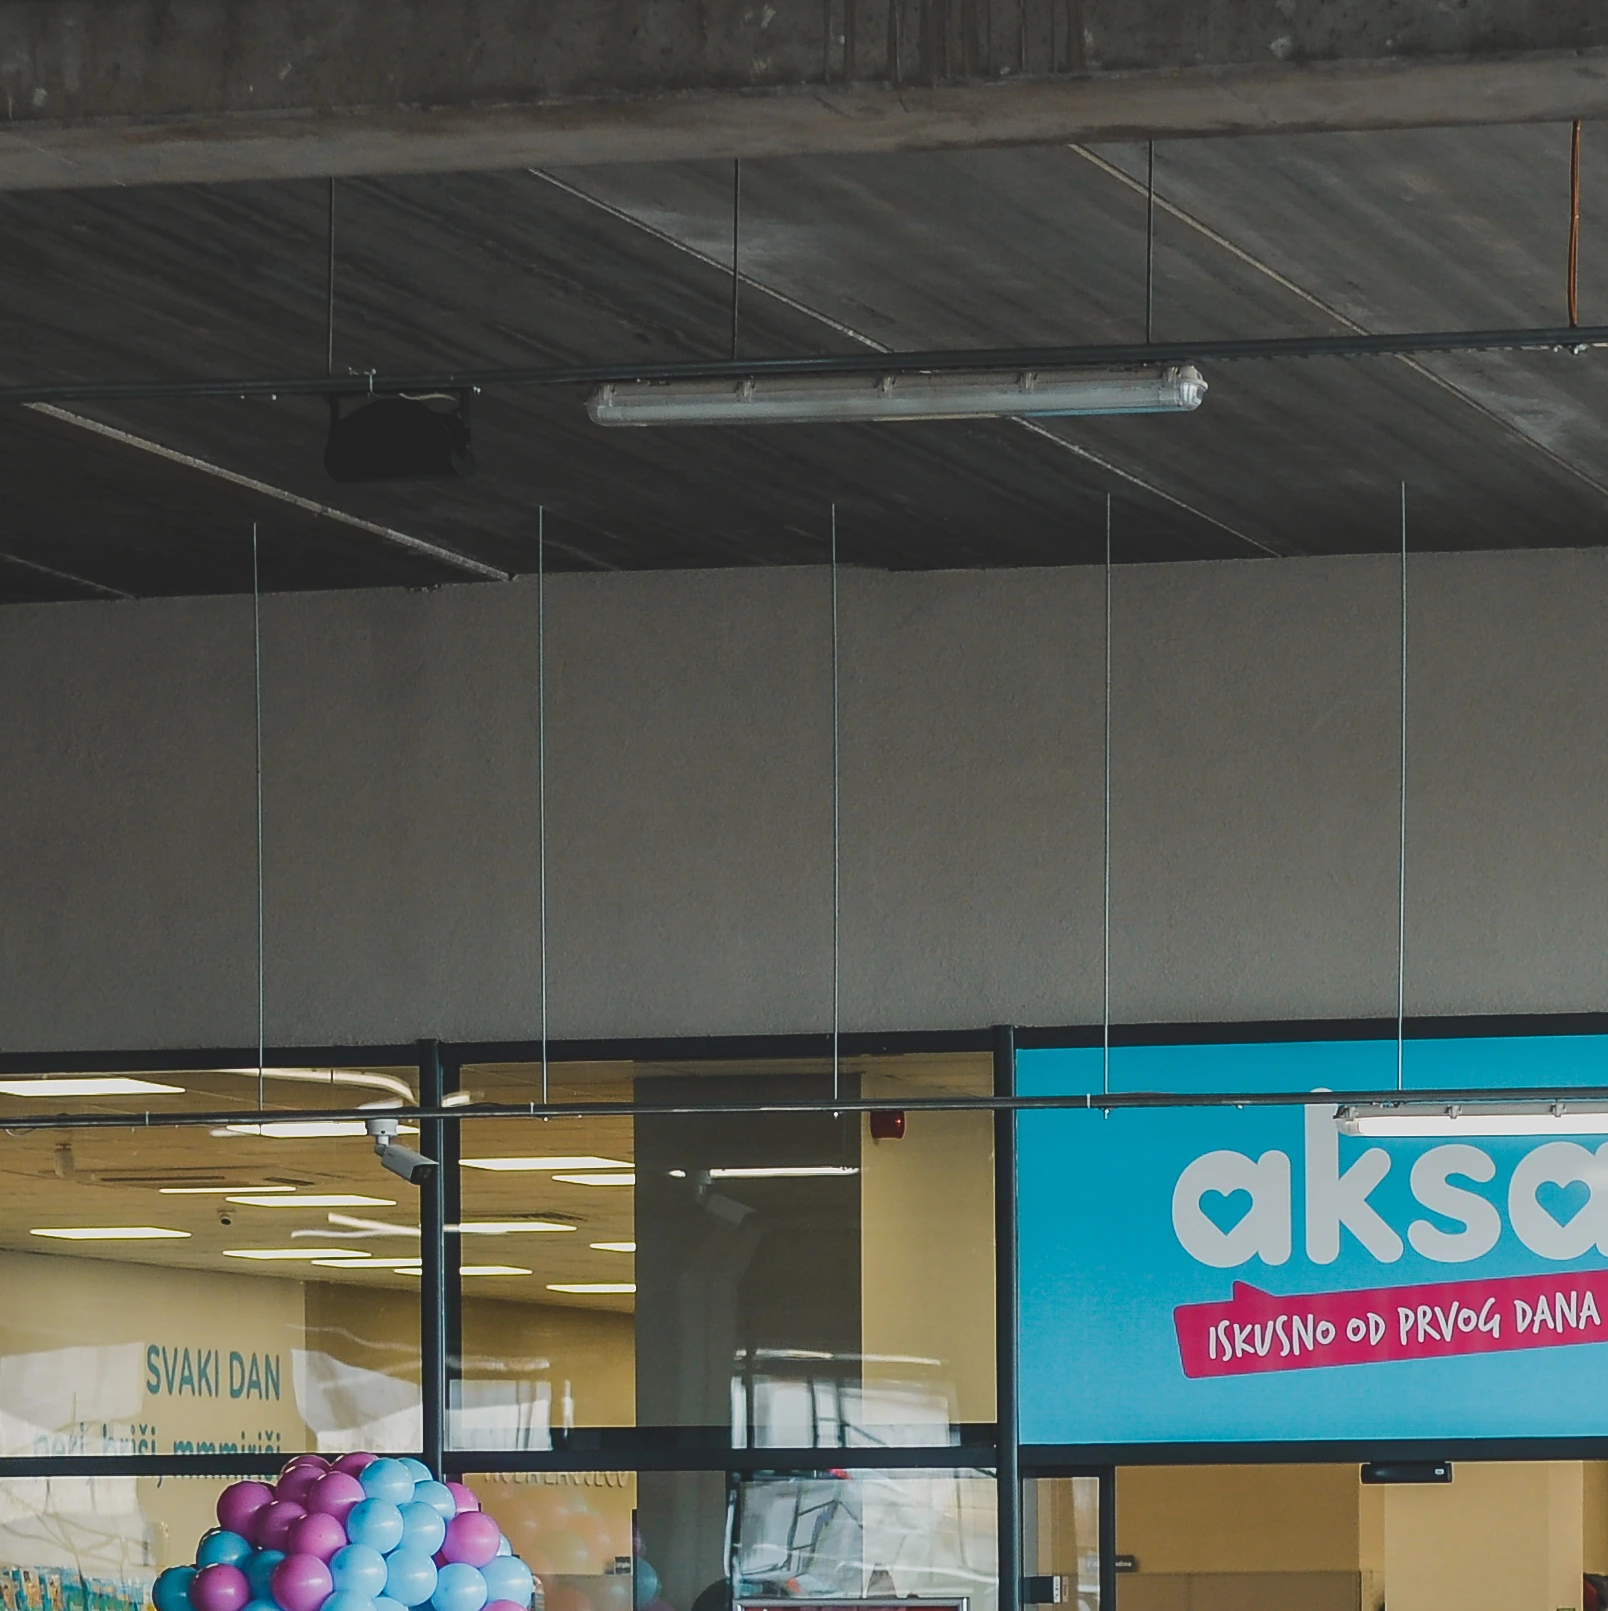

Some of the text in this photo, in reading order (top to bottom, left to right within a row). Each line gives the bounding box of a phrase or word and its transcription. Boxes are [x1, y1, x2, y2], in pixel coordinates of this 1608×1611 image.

[1208, 1291, 1601, 1362] ISKUSNO OD PRVOG DANA
[146, 1344, 281, 1401] SVAKI DAN
